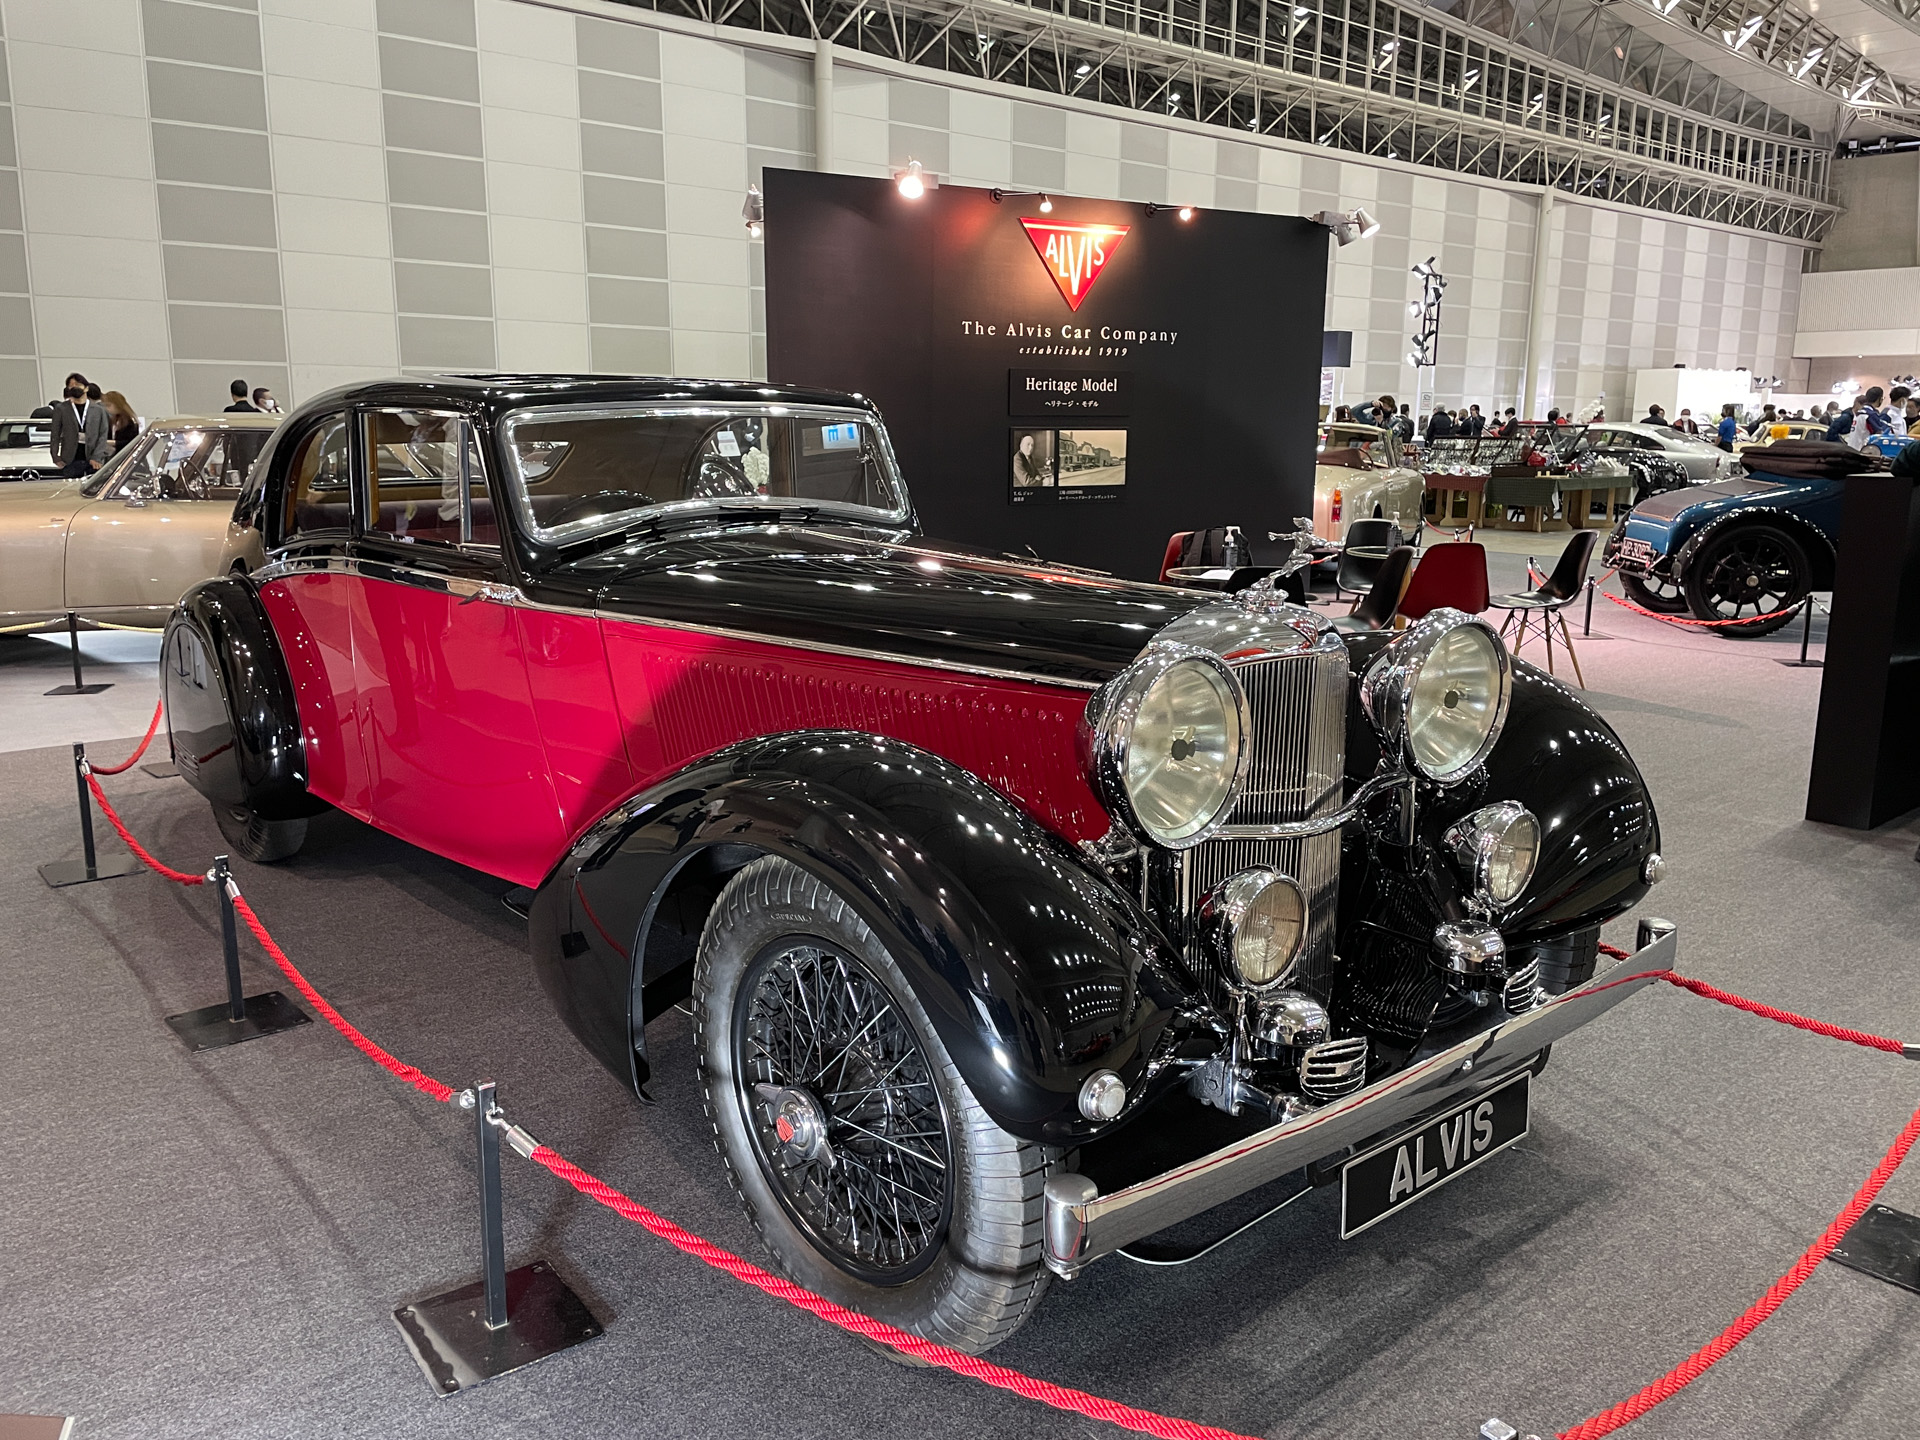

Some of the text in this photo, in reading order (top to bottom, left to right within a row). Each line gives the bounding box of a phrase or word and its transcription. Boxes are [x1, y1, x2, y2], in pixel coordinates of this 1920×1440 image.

[1045, 233, 1105, 295] ALVIS
[962, 321, 1178, 345] The Alvis Car Company
[1019, 345, 1128, 357] established 1919
[1025, 377, 1118, 394] Heritage Model
[1389, 1100, 1494, 1203] ALVIS
